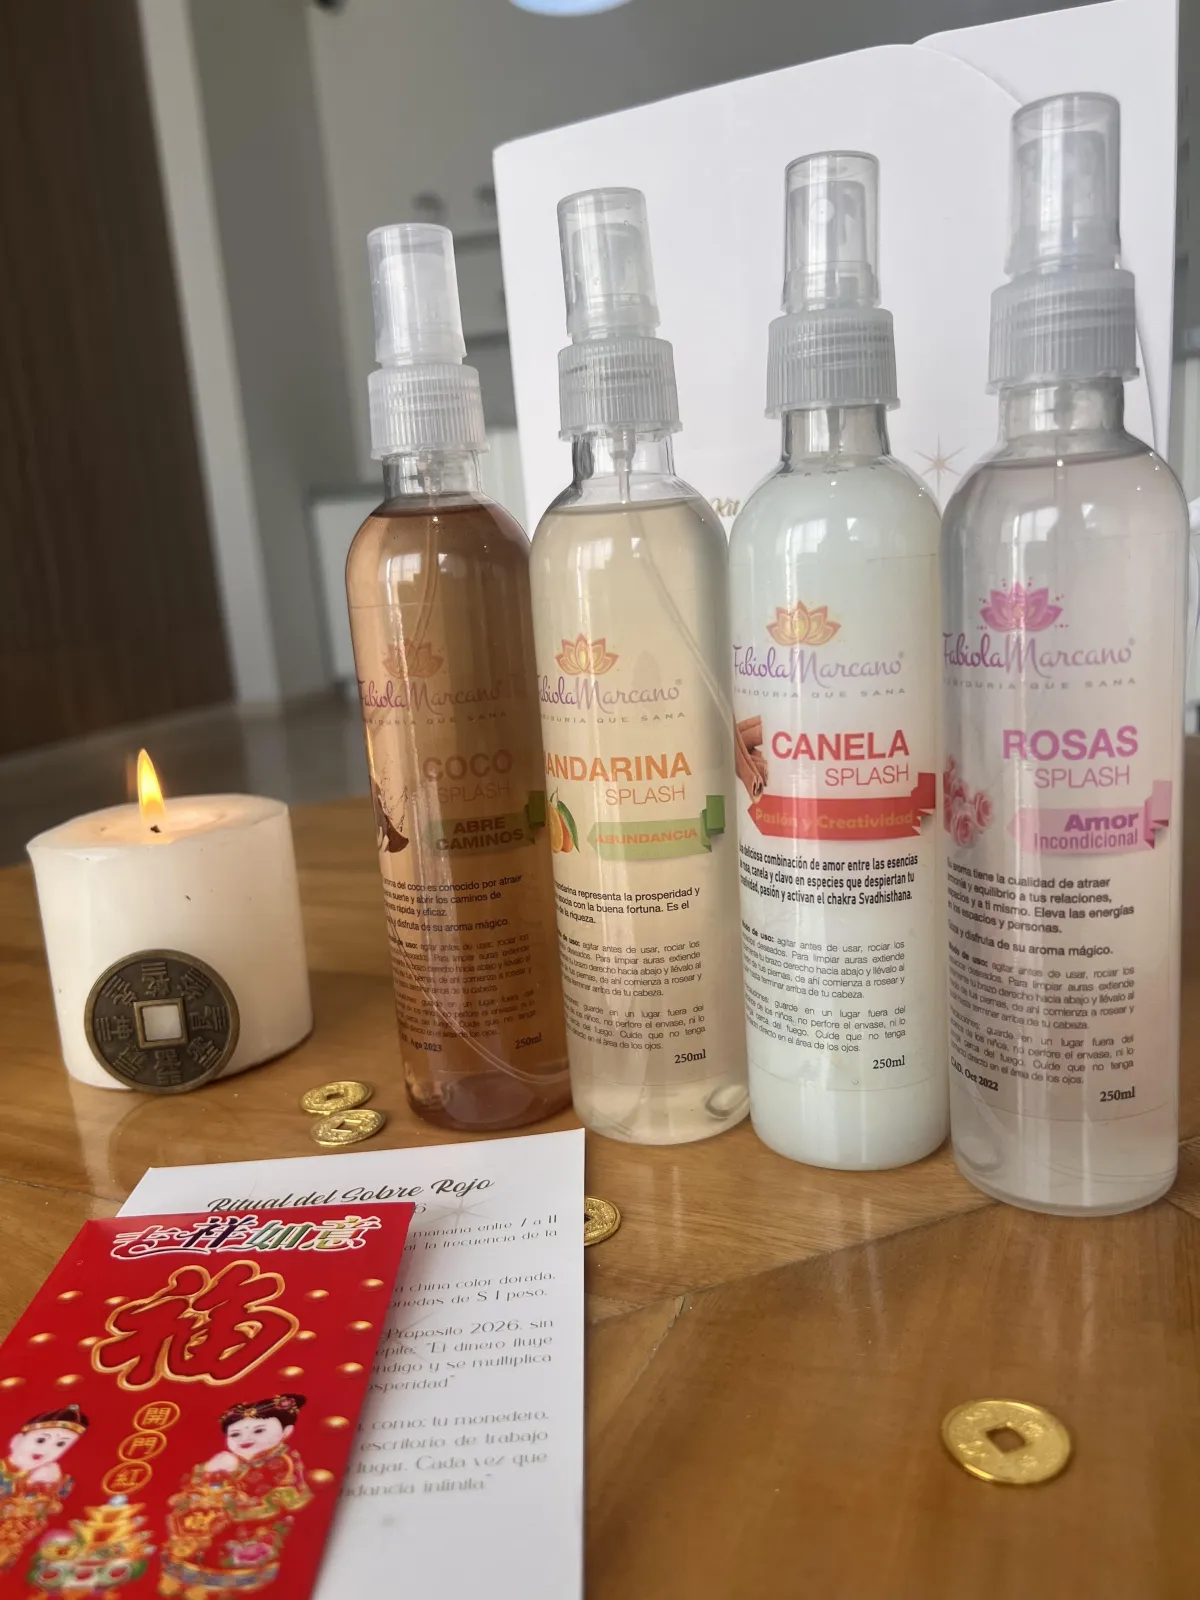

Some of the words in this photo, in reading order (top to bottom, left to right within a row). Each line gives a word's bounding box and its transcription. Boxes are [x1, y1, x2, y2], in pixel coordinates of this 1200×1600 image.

[943, 632, 1005, 669] Fabiola
[1005, 635, 1131, 678] Marcano
[733, 644, 788, 678] Fabiola
[788, 649, 901, 689] Marcano
[1084, 678, 1136, 688] SANA
[406, 683, 500, 716] Marcano
[575, 677, 679, 714] Marcano
[861, 688, 906, 697] SANA
[641, 712, 686, 722] SANA
[772, 730, 910, 761] CANELA
[1002, 725, 1139, 761] ROSAS
[423, 750, 513, 782] COCO
[825, 763, 909, 787] SPLASH
[1034, 765, 1130, 788] SPLASH
[438, 780, 510, 804] SPLASH
[605, 783, 686, 806] SPLASH
[453, 817, 505, 834] ABRE
[816, 810, 913, 829] Creatividad
[1064, 813, 1139, 832] Amor
[435, 829, 524, 850] CAMINOS
[596, 828, 698, 844] ABUNDANCIA
[1034, 828, 1138, 850] Incondicional
[764, 853, 807, 870] combinación
[810, 858, 819, 870] de
[822, 860, 845, 871] amor
[848, 859, 869, 871] entre
[872, 857, 884, 870] las
[887, 854, 918, 869] esencias
[408, 882, 425, 891] coco
[428, 884, 437, 892] es
[439, 881, 479, 892] conocido
[482, 879, 496, 890] por
[500, 874, 522, 886] atraer
[752, 865, 768, 880] canela
[775, 870, 792, 885] clavo
[795, 876, 804, 886] en
[807, 876, 843, 889] especies
[847, 878, 862, 891] que
[865, 874, 906, 889] despiertan
[908, 871, 914, 883] tu
[973, 869, 994, 884] tiene
[997, 873, 1005, 884] la
[1008, 877, 1055, 889] cualidad
[1058, 878, 1074, 889] de
[1077, 877, 1110, 889] atraer
[417, 893, 433, 904] abrir
[436, 894, 448, 904] los
[450, 892, 487, 904] caminos
[490, 890, 501, 899] de
[578, 890, 621, 901] representa
[624, 893, 632, 901] la
[635, 887, 692, 902] prosperidad
[694, 887, 700, 897] y
[760, 885, 779, 899] pasión
[781, 890, 785, 902] y
[787, 889, 814, 904] activan
[817, 892, 825, 904] el
[827, 892, 856, 905] chakra
[859, 888, 912, 905] Svadhisthana.
[974, 881, 1016, 900] equilibrio
[1030, 892, 1046, 903] tus
[1050, 893, 1112, 904] relaciones,
[423, 908, 448, 917] eficaz.
[573, 900, 585, 909] con
[587, 902, 594, 912] la
[597, 904, 623, 914] buena
[627, 903, 663, 914] fortuna.
[667, 902, 678, 912] Es
[681, 901, 689, 909] el
[993, 903, 1030, 916] mismo.
[1035, 907, 1065, 918] Eleva
[1069, 907, 1085, 918] las
[1089, 905, 1134, 919] energías
[570, 911, 596, 924] riqueza.
[962, 906, 996, 926] espacios
[1008, 921, 1062, 933] personas.
[421, 922, 431, 932] de
[433, 923, 442, 932] su
[445, 921, 472, 932] aroma
[603, 945, 622, 953] antes
[641, 945, 660, 954] usar,
[664, 942, 685, 952] rociar
[689, 940, 700, 948] los
[761, 933, 774, 942] uso:
[777, 937, 796, 948] agitar
[800, 943, 822, 951] antes
[827, 943, 837, 952] de
[843, 945, 863, 953] usar,
[868, 942, 890, 952] rociar
[894, 941, 904, 949] los
[965, 930, 995, 948] disfruta
[997, 938, 1009, 950] de
[1013, 943, 1025, 953] su
[1029, 944, 1065, 956] aroma
[1069, 944, 1113, 958] mágico.
[813, 954, 839, 964] limpiar
[845, 955, 867, 964] auras
[872, 952, 905, 963] extiende
[784, 961, 814, 973] derecho
[816, 966, 838, 975] hacia
[841, 968, 863, 977] abajo
[873, 965, 896, 975] llévalo
[623, 988, 631, 996] tu
[633, 987, 664, 997] cabeza.
[775, 1000, 798, 1012] guarde
[840, 1009, 860, 1019] lugar
[868, 1008, 888, 1017] fuera
[423, 1042, 442, 1051] 2023
[515, 1033, 542, 1049] 250ml
[674, 1049, 706, 1064] 250ml
[873, 1055, 905, 1069] 250ml
[965, 1070, 977, 1083] Oct
[978, 1075, 999, 1091] 2022
[1100, 1086, 1136, 1102] 250ml
[294, 1190, 338, 1207] del
[341, 1184, 424, 1205] Sobre
[431, 1178, 495, 1197] Rojo
[522, 1230, 539, 1240] de
[546, 1229, 557, 1237] la
[410, 1280, 450, 1292] china
[456, 1278, 492, 1289] color
[452, 1294, 470, 1304] de
[507, 1288, 547, 1301] peso.
[90, 1258, 301, 1393] 福
[530, 1320, 554, 1328] sin
[454, 1340, 505, 1352] dinero
[430, 1362, 440, 1372] y
[447, 1359, 465, 1369] se
[433, 1415, 448, 1427] tu
[455, 1433, 476, 1447] de
[486, 1430, 548, 1446] trabajo
[416, 1455, 466, 1471] Cada
[512, 1452, 548, 1468] que
